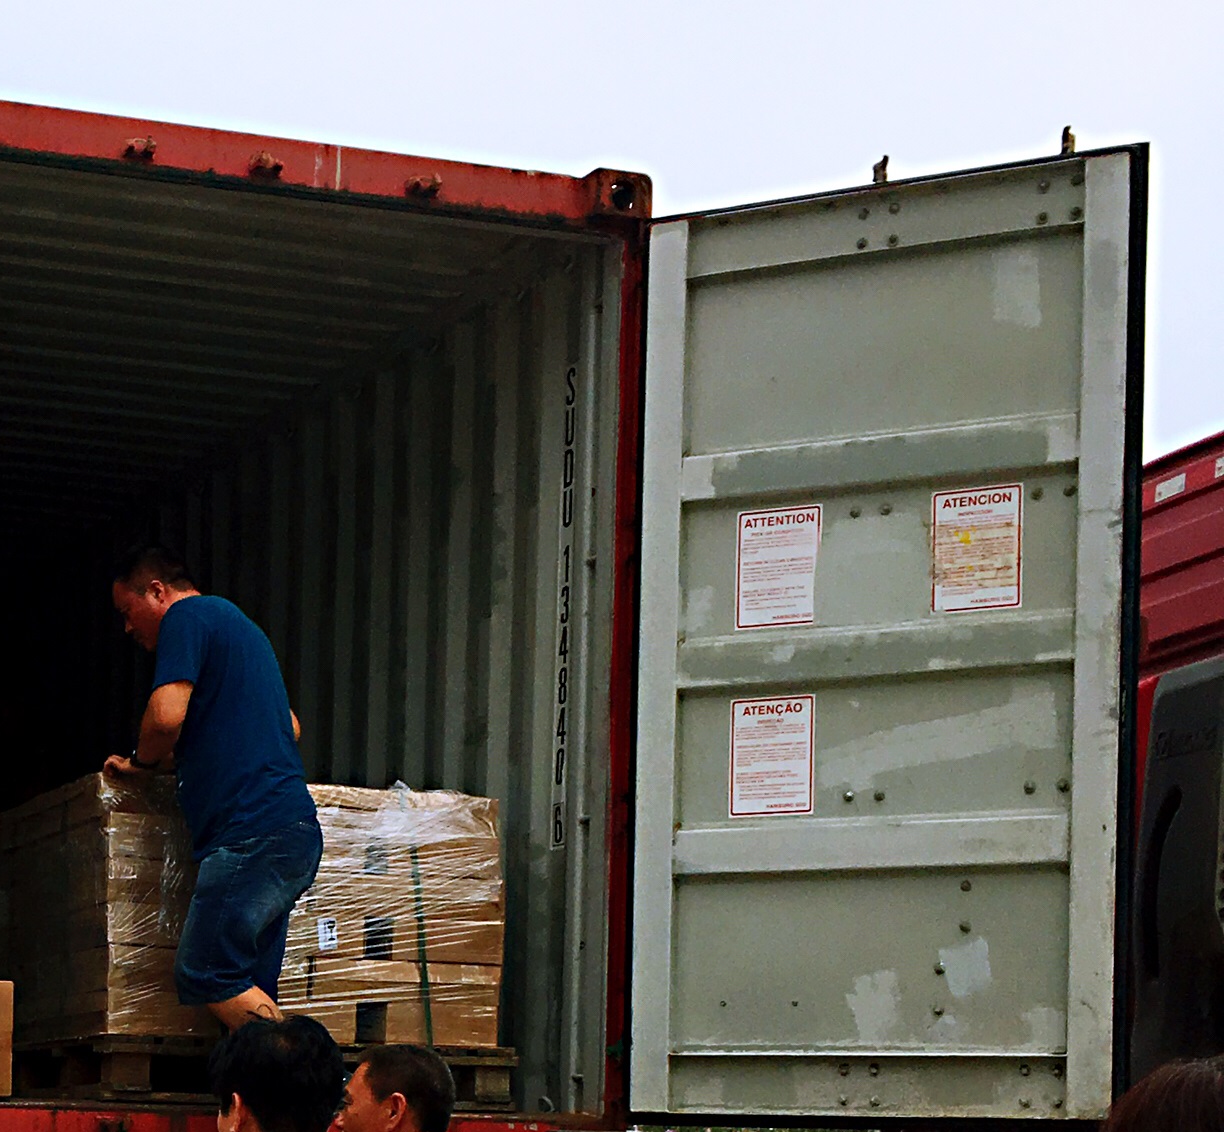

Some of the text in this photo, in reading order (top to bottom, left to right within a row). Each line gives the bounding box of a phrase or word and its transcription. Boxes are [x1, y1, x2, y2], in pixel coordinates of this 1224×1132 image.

[562, 367, 576, 529] SUDU
[942, 492, 1012, 509] ATENCION
[744, 513, 815, 528] ATTENTION
[742, 701, 803, 716] ATENÇÃO
